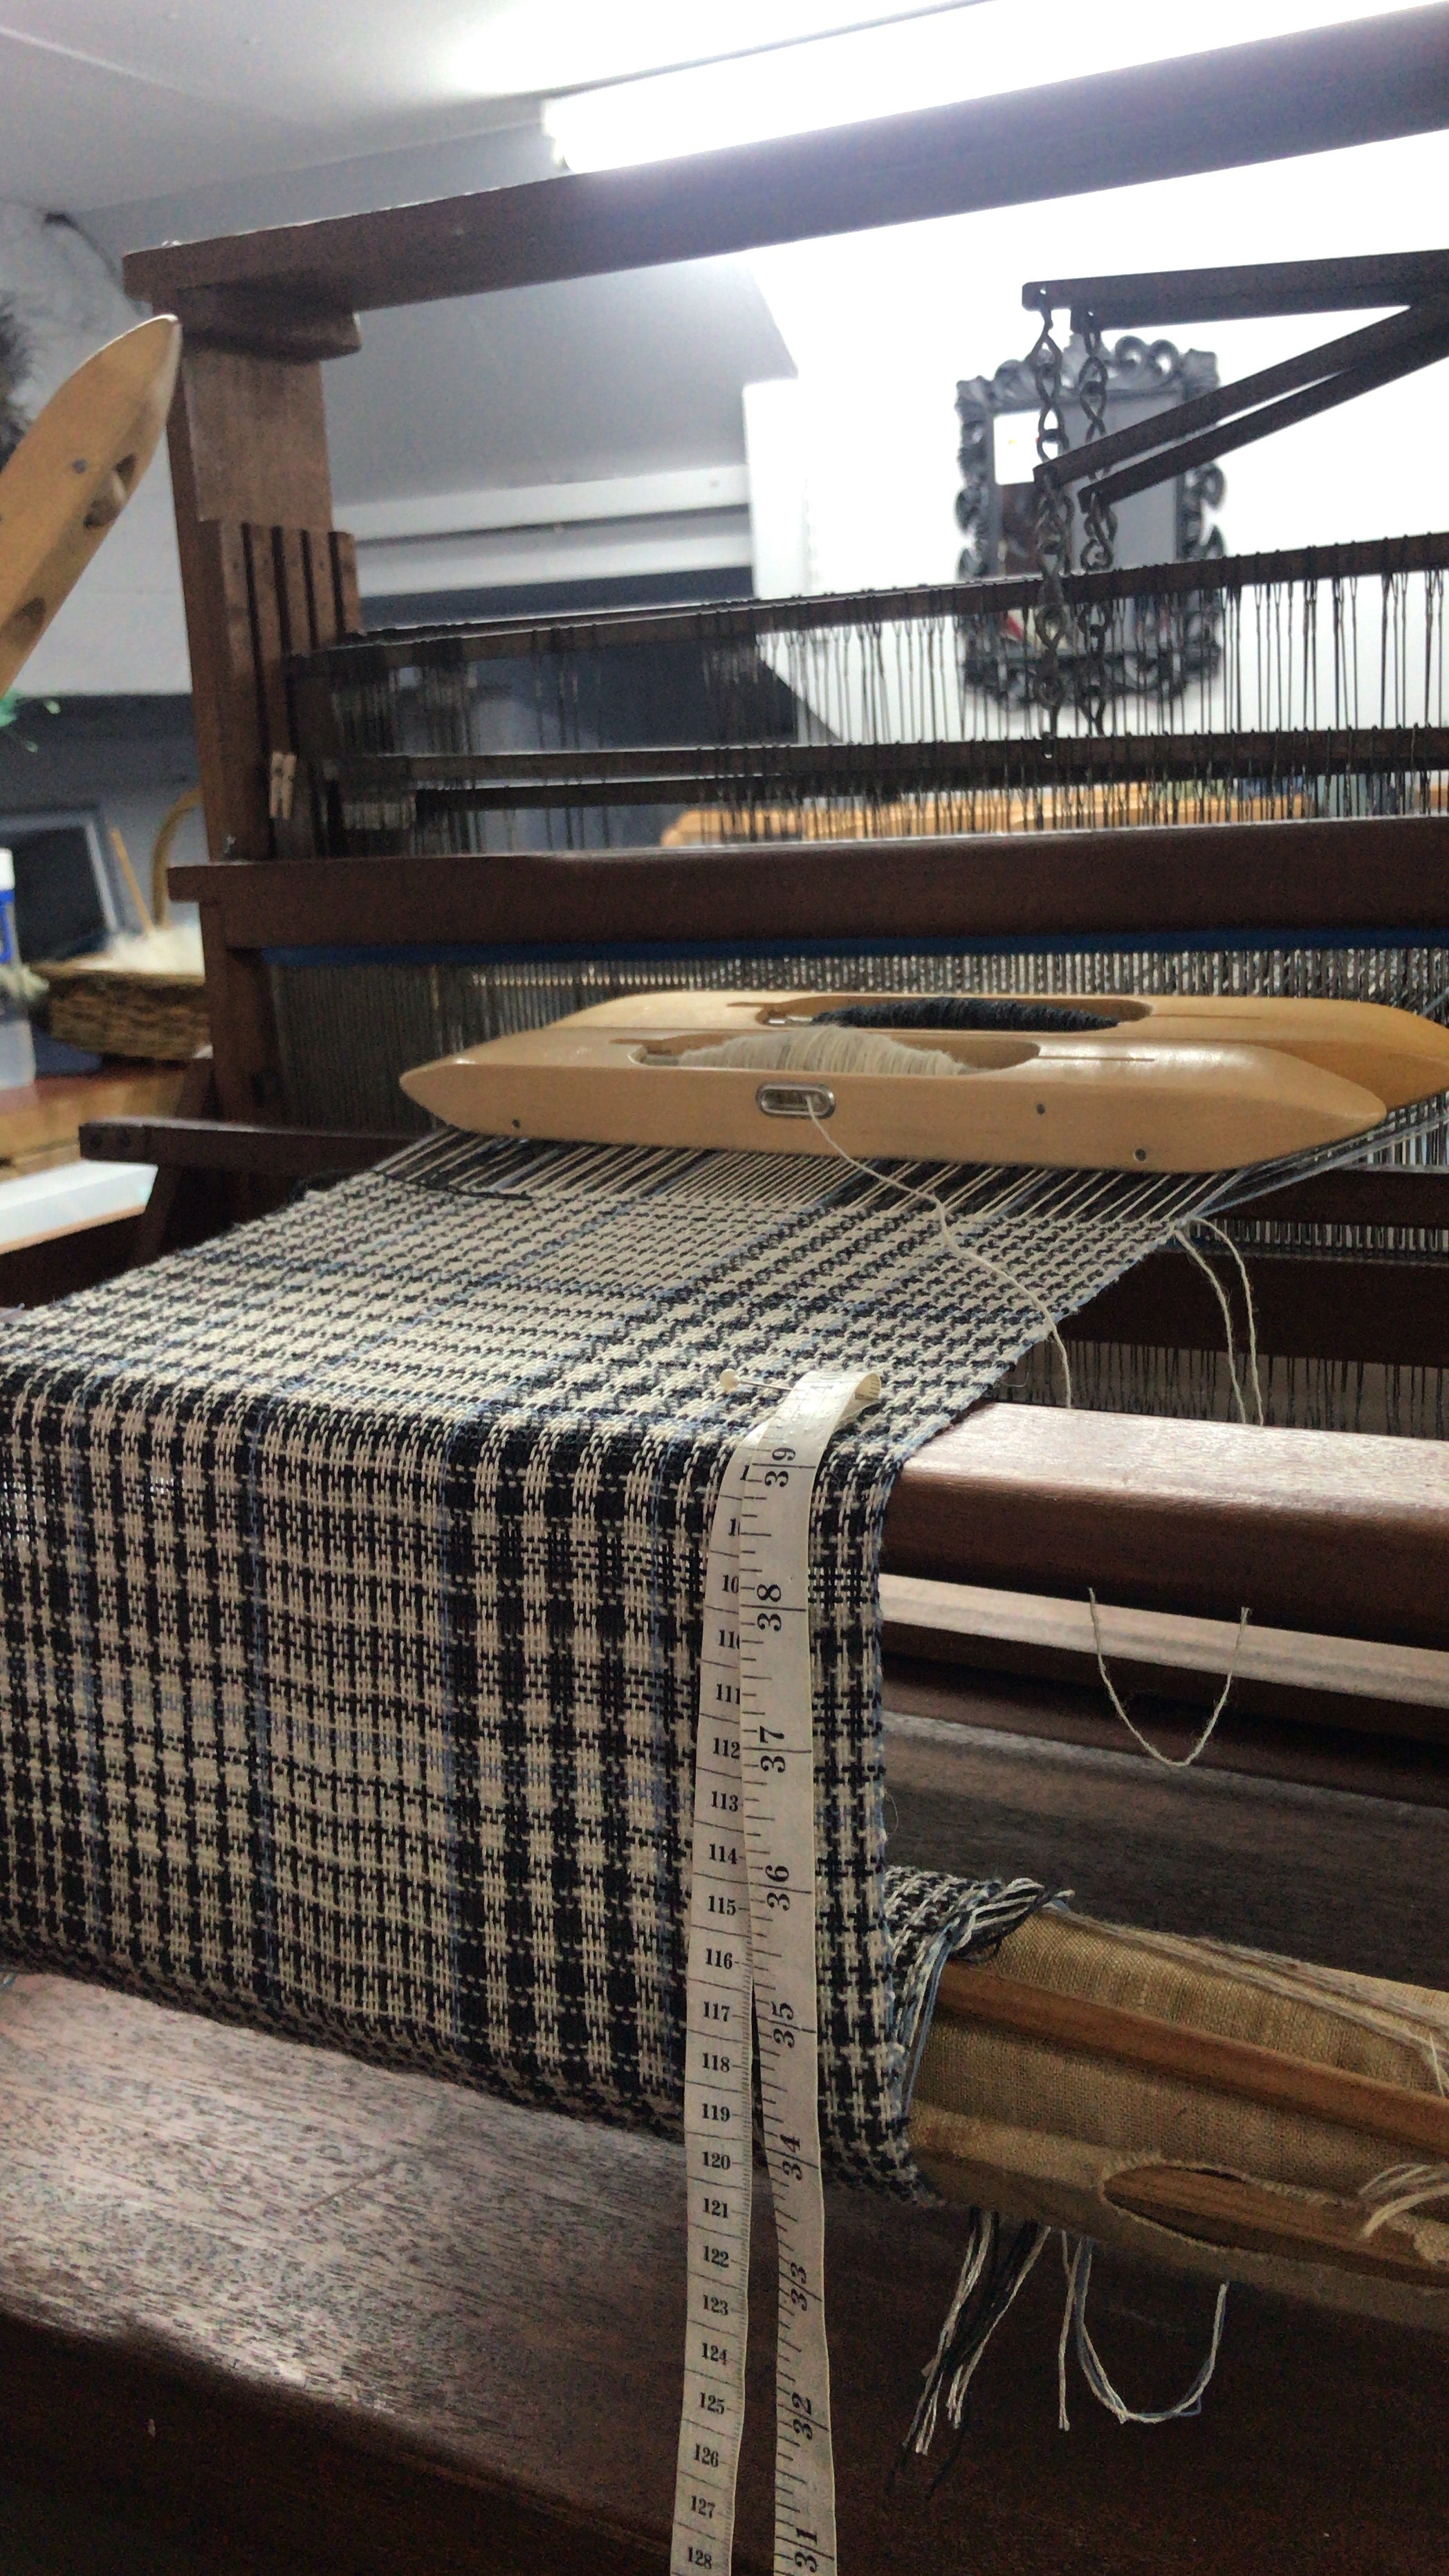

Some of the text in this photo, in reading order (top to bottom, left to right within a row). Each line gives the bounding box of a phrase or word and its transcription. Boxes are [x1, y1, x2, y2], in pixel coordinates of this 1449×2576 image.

[764, 1448, 795, 1487] 39
[721, 1575, 739, 1594] 10
[757, 1584, 782, 1631] 38
[712, 1738, 740, 1759] 112
[759, 1725, 786, 1773] 37
[710, 1791, 739, 1812] 113
[709, 1843, 737, 1864] 114
[765, 1865, 790, 1911] 36
[708, 1895, 736, 1915] 115
[705, 1948, 733, 1969] 116
[703, 2001, 730, 2022] 117
[771, 2001, 795, 2048] 35
[702, 2052, 730, 2072] 118
[701, 2103, 730, 2122] 119
[702, 2151, 731, 2170] 120
[779, 2134, 802, 2180] 34
[702, 2198, 729, 2219] 121
[703, 2245, 729, 2268] 122
[790, 2262, 807, 2311] 33
[703, 2294, 729, 2315] 123
[701, 2343, 727, 2365] 124
[699, 2392, 725, 2415] 125
[791, 2392, 813, 2440] 32
[694, 2443, 719, 2467] 126
[691, 2495, 716, 2519] 127
[687, 2546, 712, 2570] 128
[795, 2528, 819, 2573] 31
